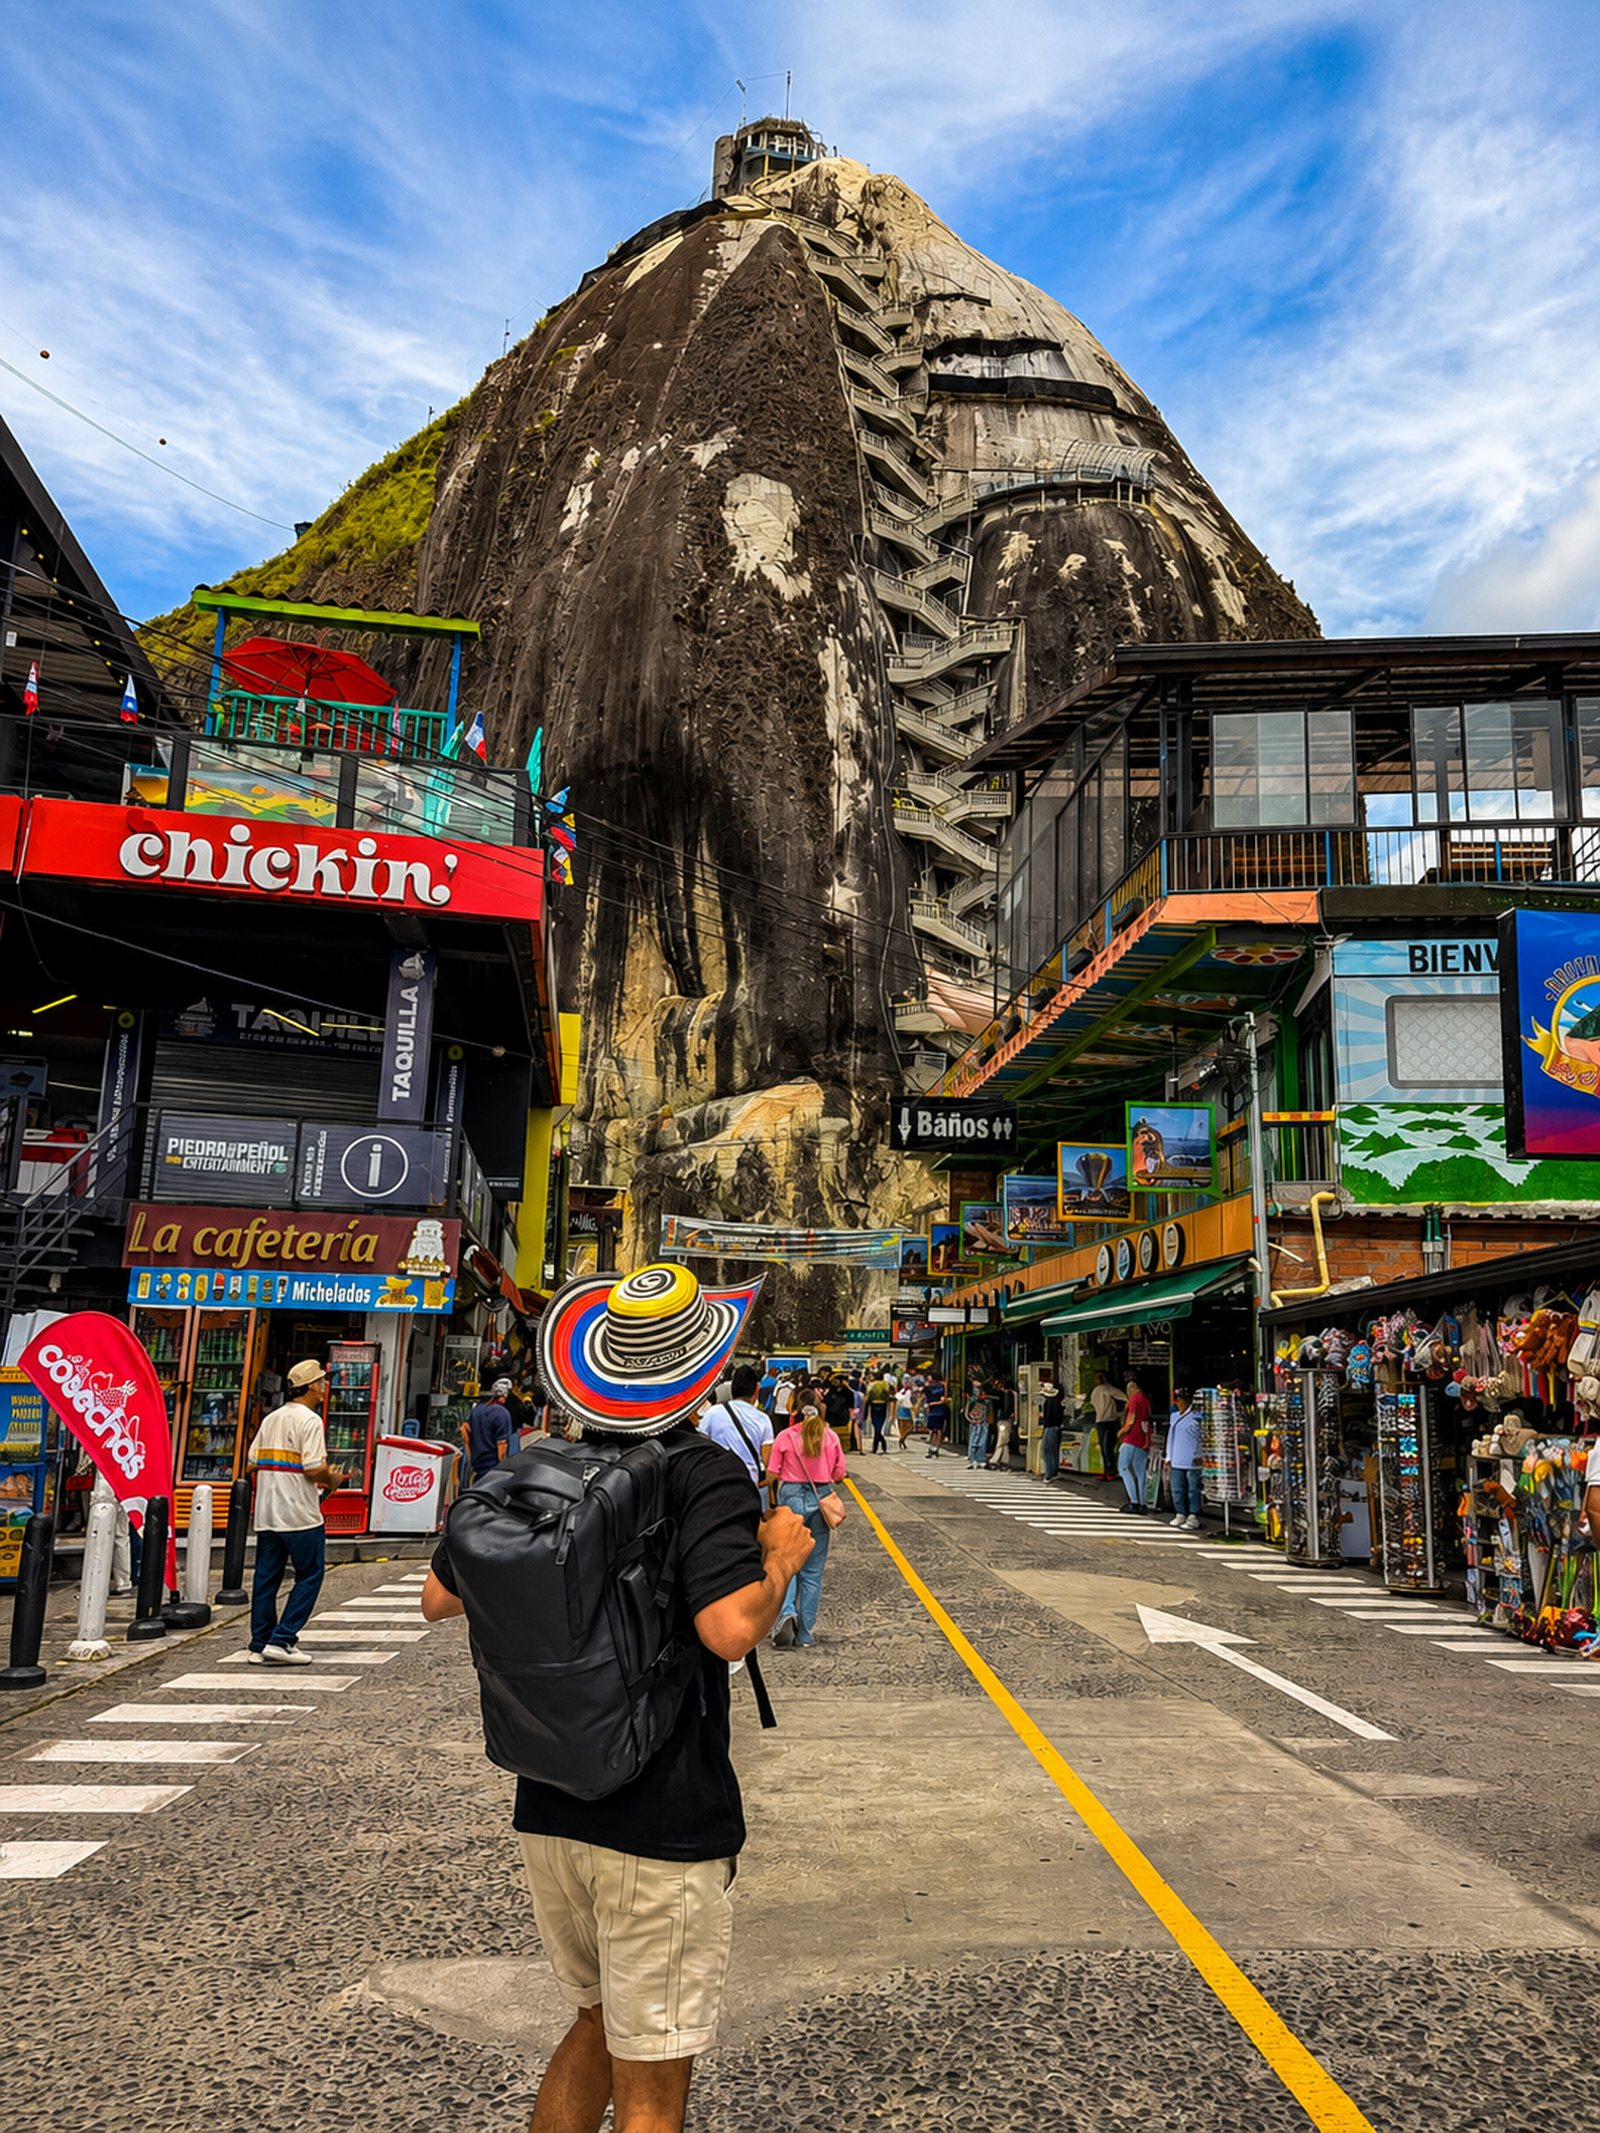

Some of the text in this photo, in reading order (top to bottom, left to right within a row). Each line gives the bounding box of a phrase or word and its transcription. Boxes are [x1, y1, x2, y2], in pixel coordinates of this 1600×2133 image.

[119, 823, 458, 906] chickin'
[391, 985, 420, 1102] TAQUILLA
[167, 1137, 226, 1157] PIEDRA
[128, 1211, 379, 1269] La cafetería
[292, 1280, 371, 1304] Michelados
